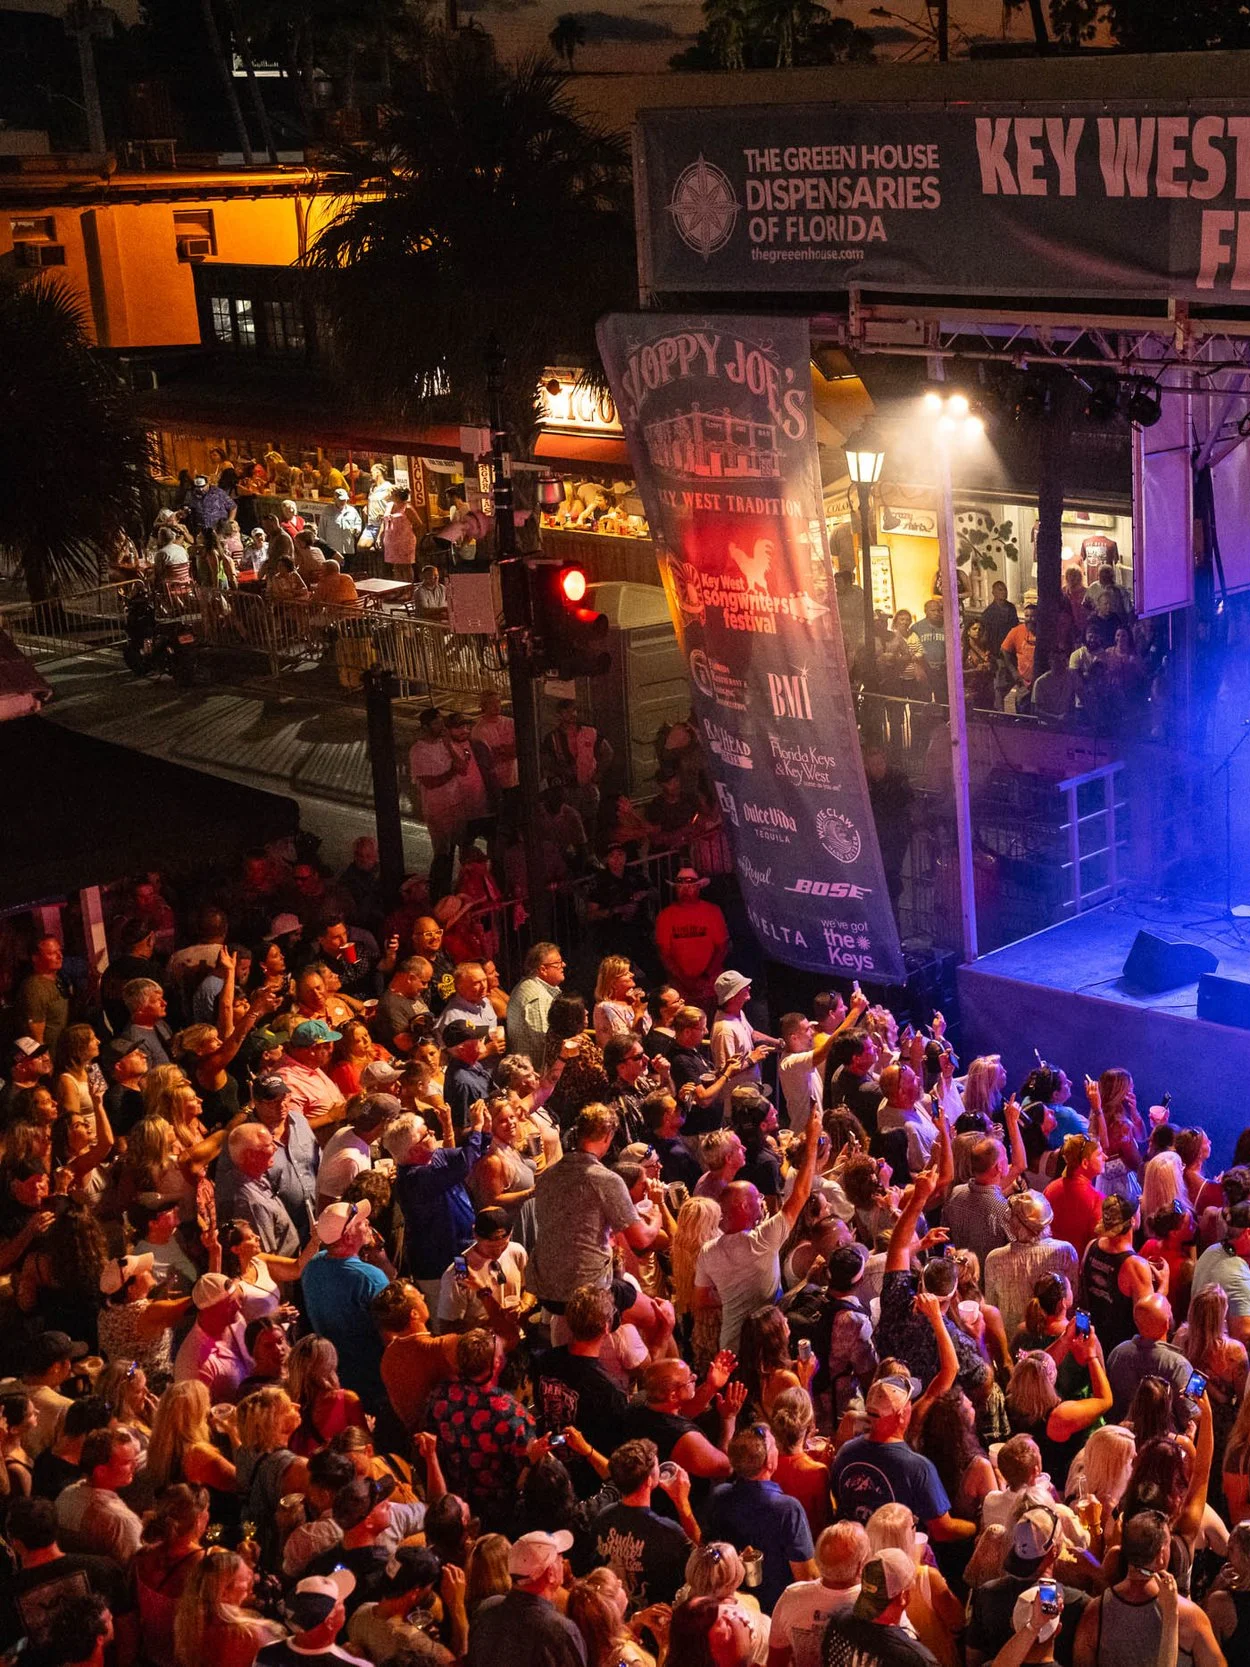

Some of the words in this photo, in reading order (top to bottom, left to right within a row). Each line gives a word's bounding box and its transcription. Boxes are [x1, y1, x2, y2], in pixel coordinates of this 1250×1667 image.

[743, 148, 781, 173] THE
[783, 144, 856, 171] GREEEN
[859, 143, 940, 169] HOUSE
[975, 116, 1085, 196] KEY
[746, 175, 941, 211] DISPENSARIES
[748, 216, 781, 244] OF
[784, 214, 888, 243] FLORIDA
[724, 339, 808, 441] JOE'S
[681, 491, 721, 512] WEST
[725, 495, 802, 518] TRADITION
[701, 572, 720, 592] Key
[720, 574, 746, 591] West
[703, 588, 790, 614] songwriters
[723, 606, 777, 635] festival
[767, 670, 813, 721] BMI
[770, 740, 808, 763] Florida
[808, 746, 836, 770] Keys
[801, 762, 831, 783] West
[826, 807, 855, 829] CLAW
[754, 828, 791, 844] TEQUILA
[784, 878, 872, 900] BOSE
[823, 928, 856, 949] the
[828, 946, 875, 972] Keys
